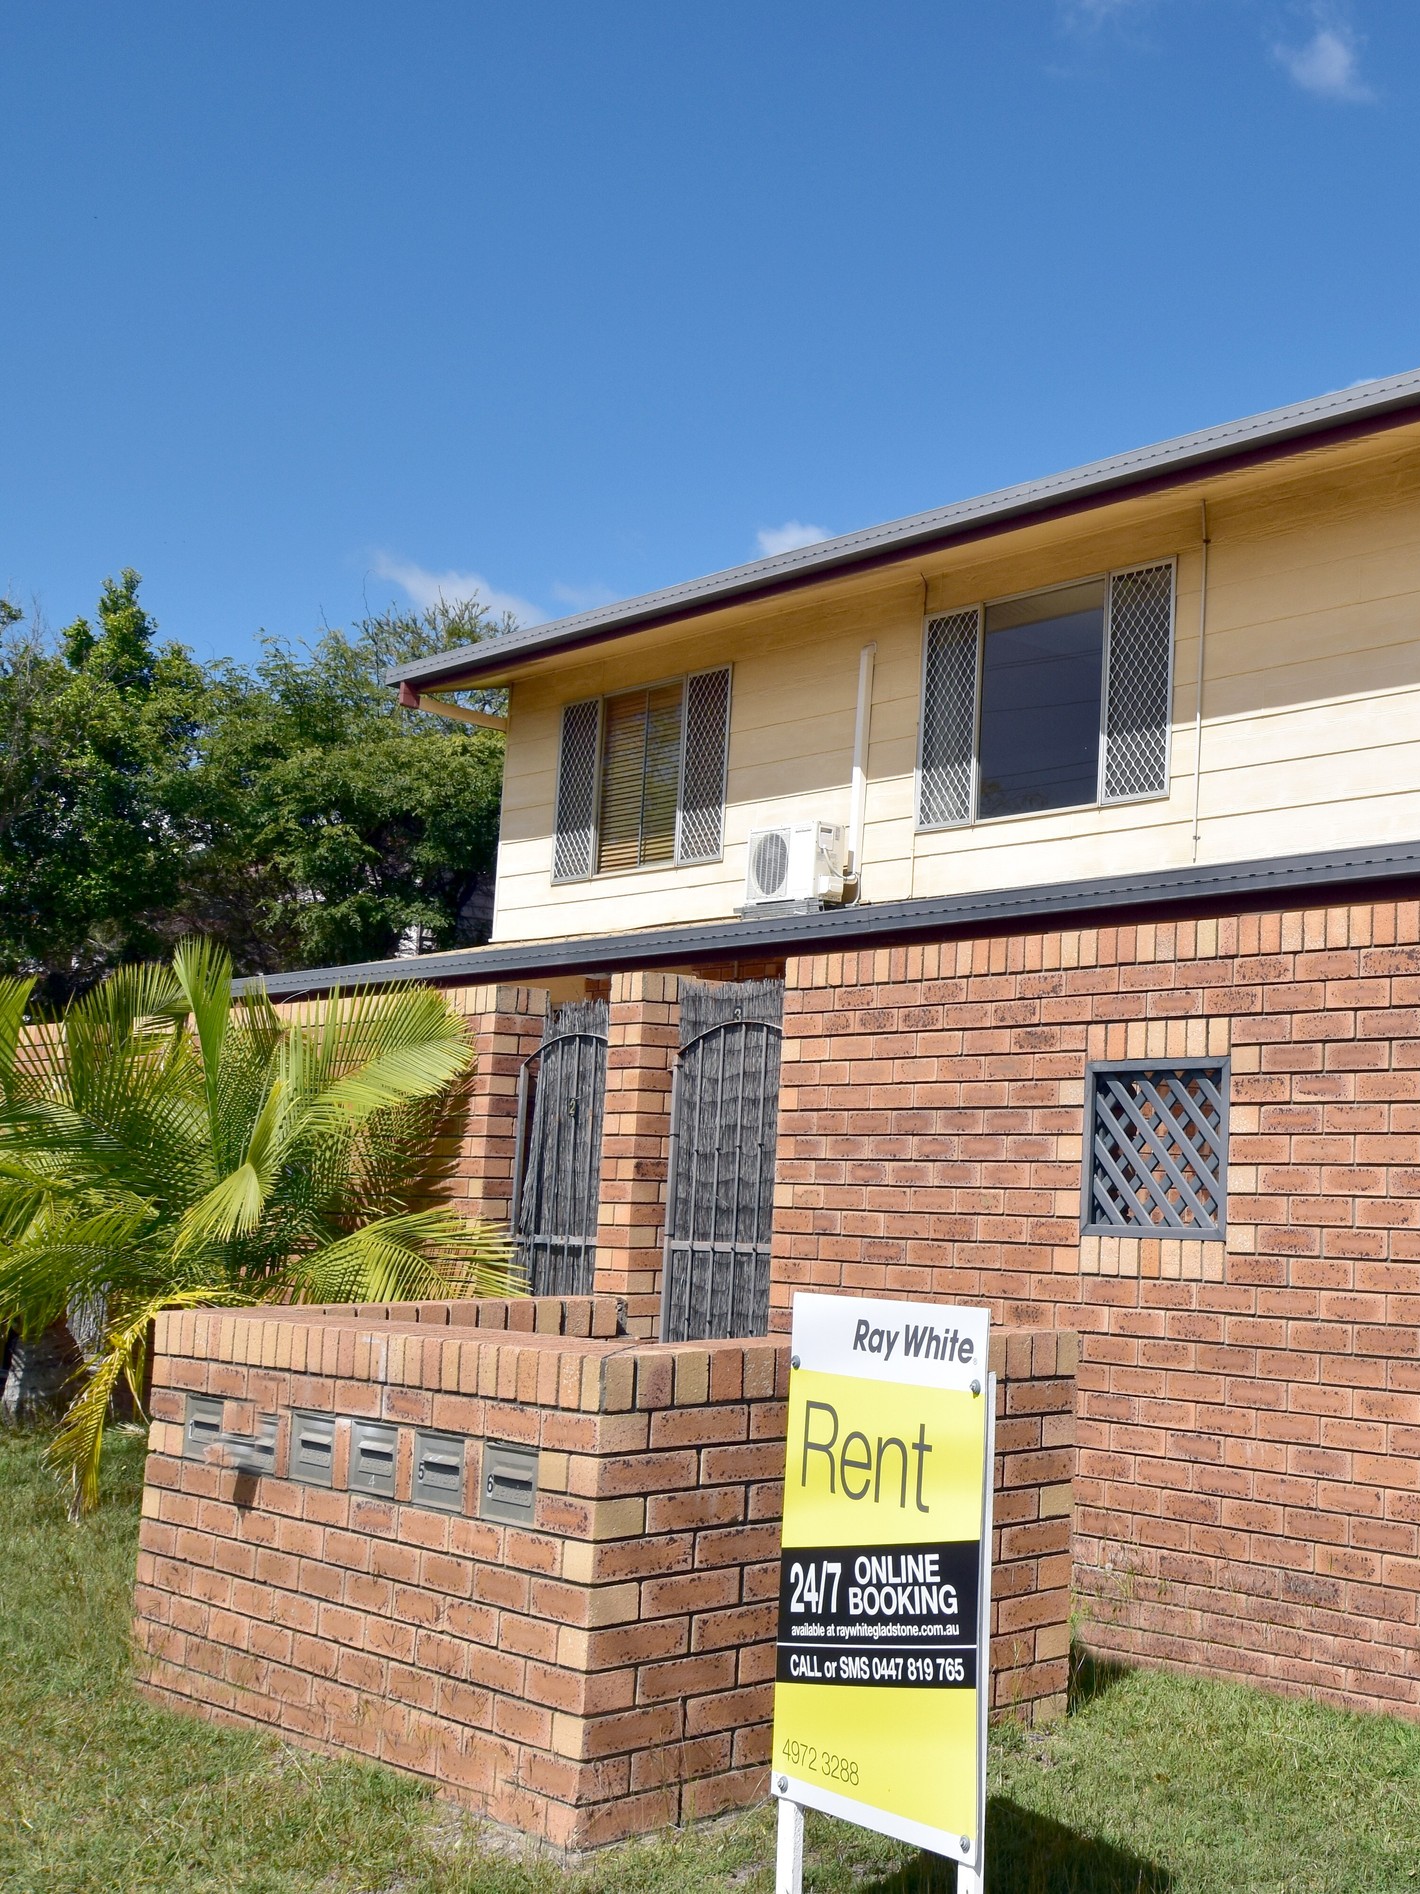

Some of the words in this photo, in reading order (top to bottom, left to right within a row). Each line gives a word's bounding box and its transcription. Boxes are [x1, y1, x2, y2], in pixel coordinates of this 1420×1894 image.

[569, 1099, 576, 1115] 2
[852, 1319, 900, 1361] Ray
[904, 1324, 975, 1364] White
[801, 1399, 933, 1514] Rent
[368, 1474, 376, 1488] 4
[487, 1474, 494, 1493] 6
[854, 1553, 941, 1585] ONLINE
[790, 1561, 842, 1614] 24/7
[849, 1585, 959, 1616] BOOKING
[791, 1622, 825, 1637] available
[826, 1623, 835, 1636] at
[836, 1623, 960, 1640] raywhitegladstone.com.au
[790, 1654, 823, 1678] CALL
[824, 1660, 838, 1679] or
[839, 1656, 870, 1679] SMS
[873, 1657, 904, 1680] 0447
[907, 1657, 934, 1681] 819
[936, 1658, 965, 1682] 765
[782, 1738, 818, 1772] 4972
[821, 1751, 860, 1786] 3288
